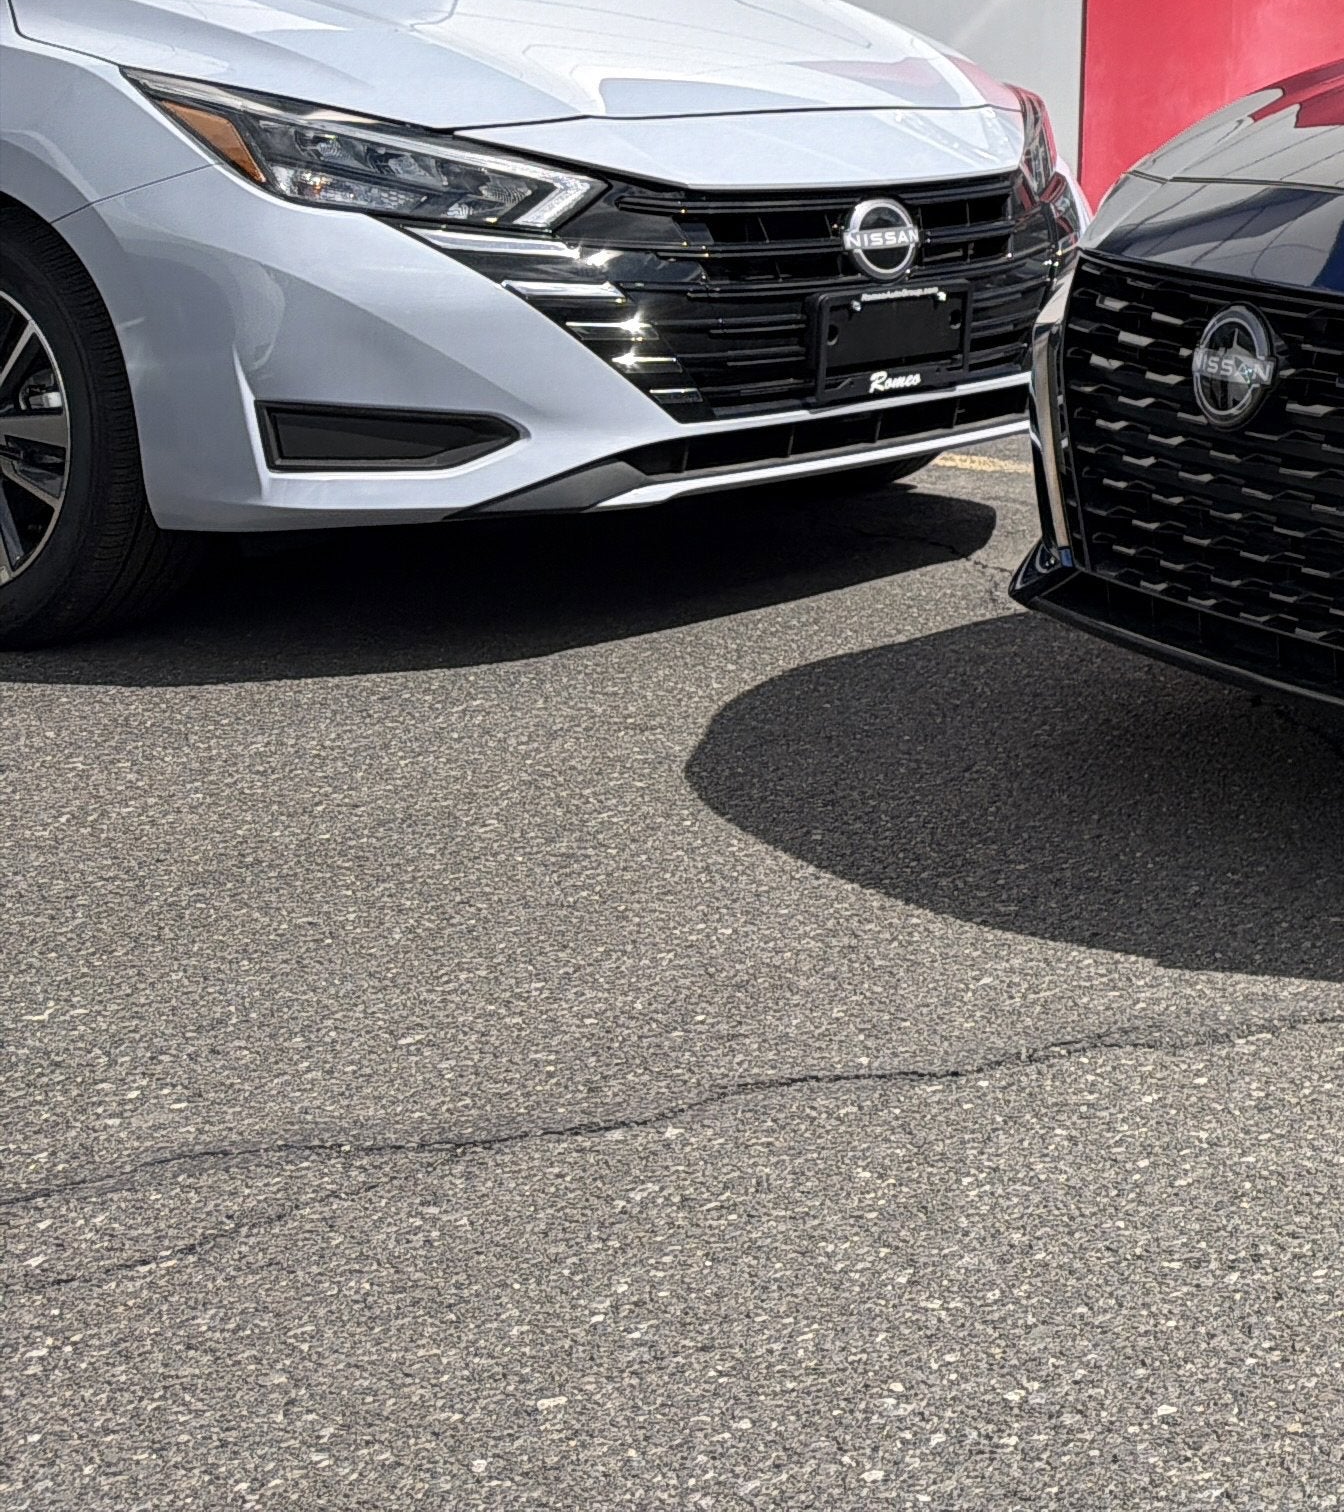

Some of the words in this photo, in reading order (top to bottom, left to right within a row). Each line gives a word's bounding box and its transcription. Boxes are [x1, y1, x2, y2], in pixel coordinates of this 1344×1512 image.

[846, 226, 919, 250] NISSAN
[1193, 349, 1271, 382] NISSAN
[868, 371, 922, 393] Romeo
